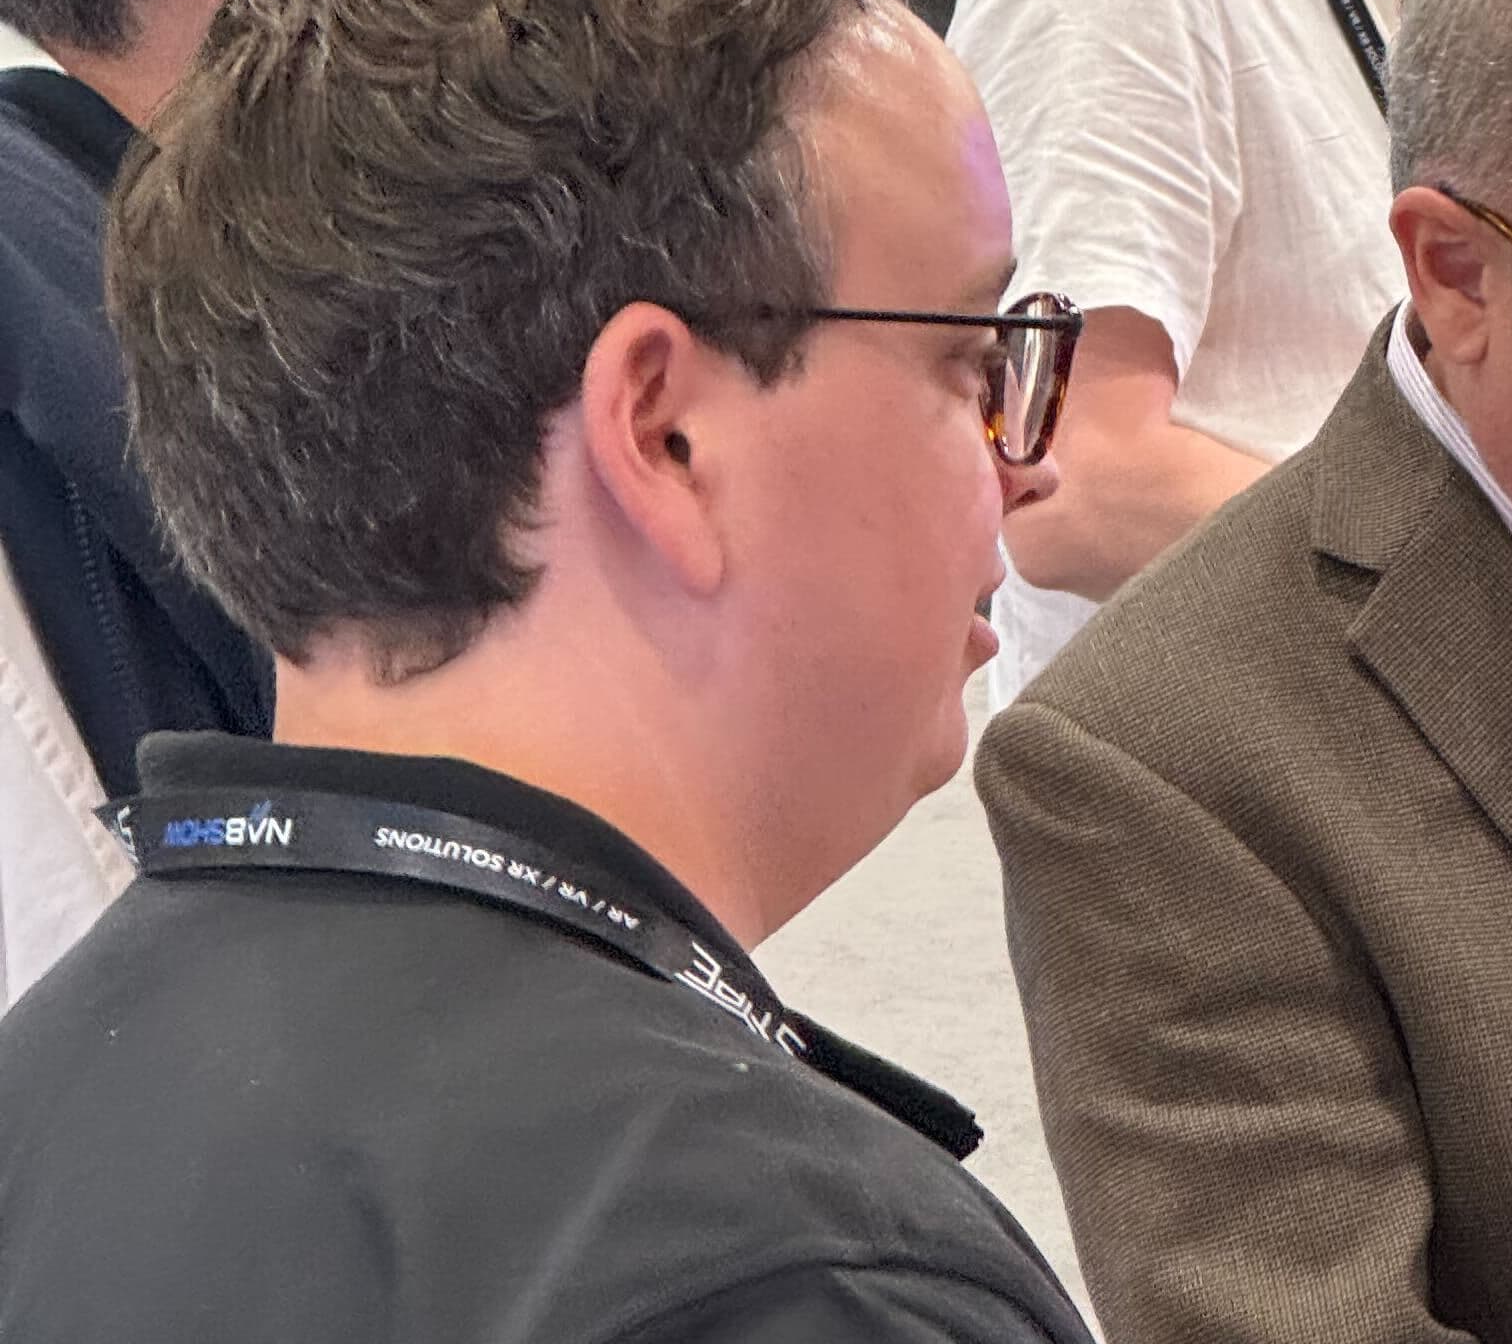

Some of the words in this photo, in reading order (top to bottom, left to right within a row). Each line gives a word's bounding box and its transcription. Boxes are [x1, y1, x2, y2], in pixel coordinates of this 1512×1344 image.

[164, 810, 292, 845] NABSHOW
[374, 827, 504, 873] SOLUTIONS
[507, 859, 541, 886] XR
[558, 881, 588, 906] VR
[607, 906, 640, 930] AR
